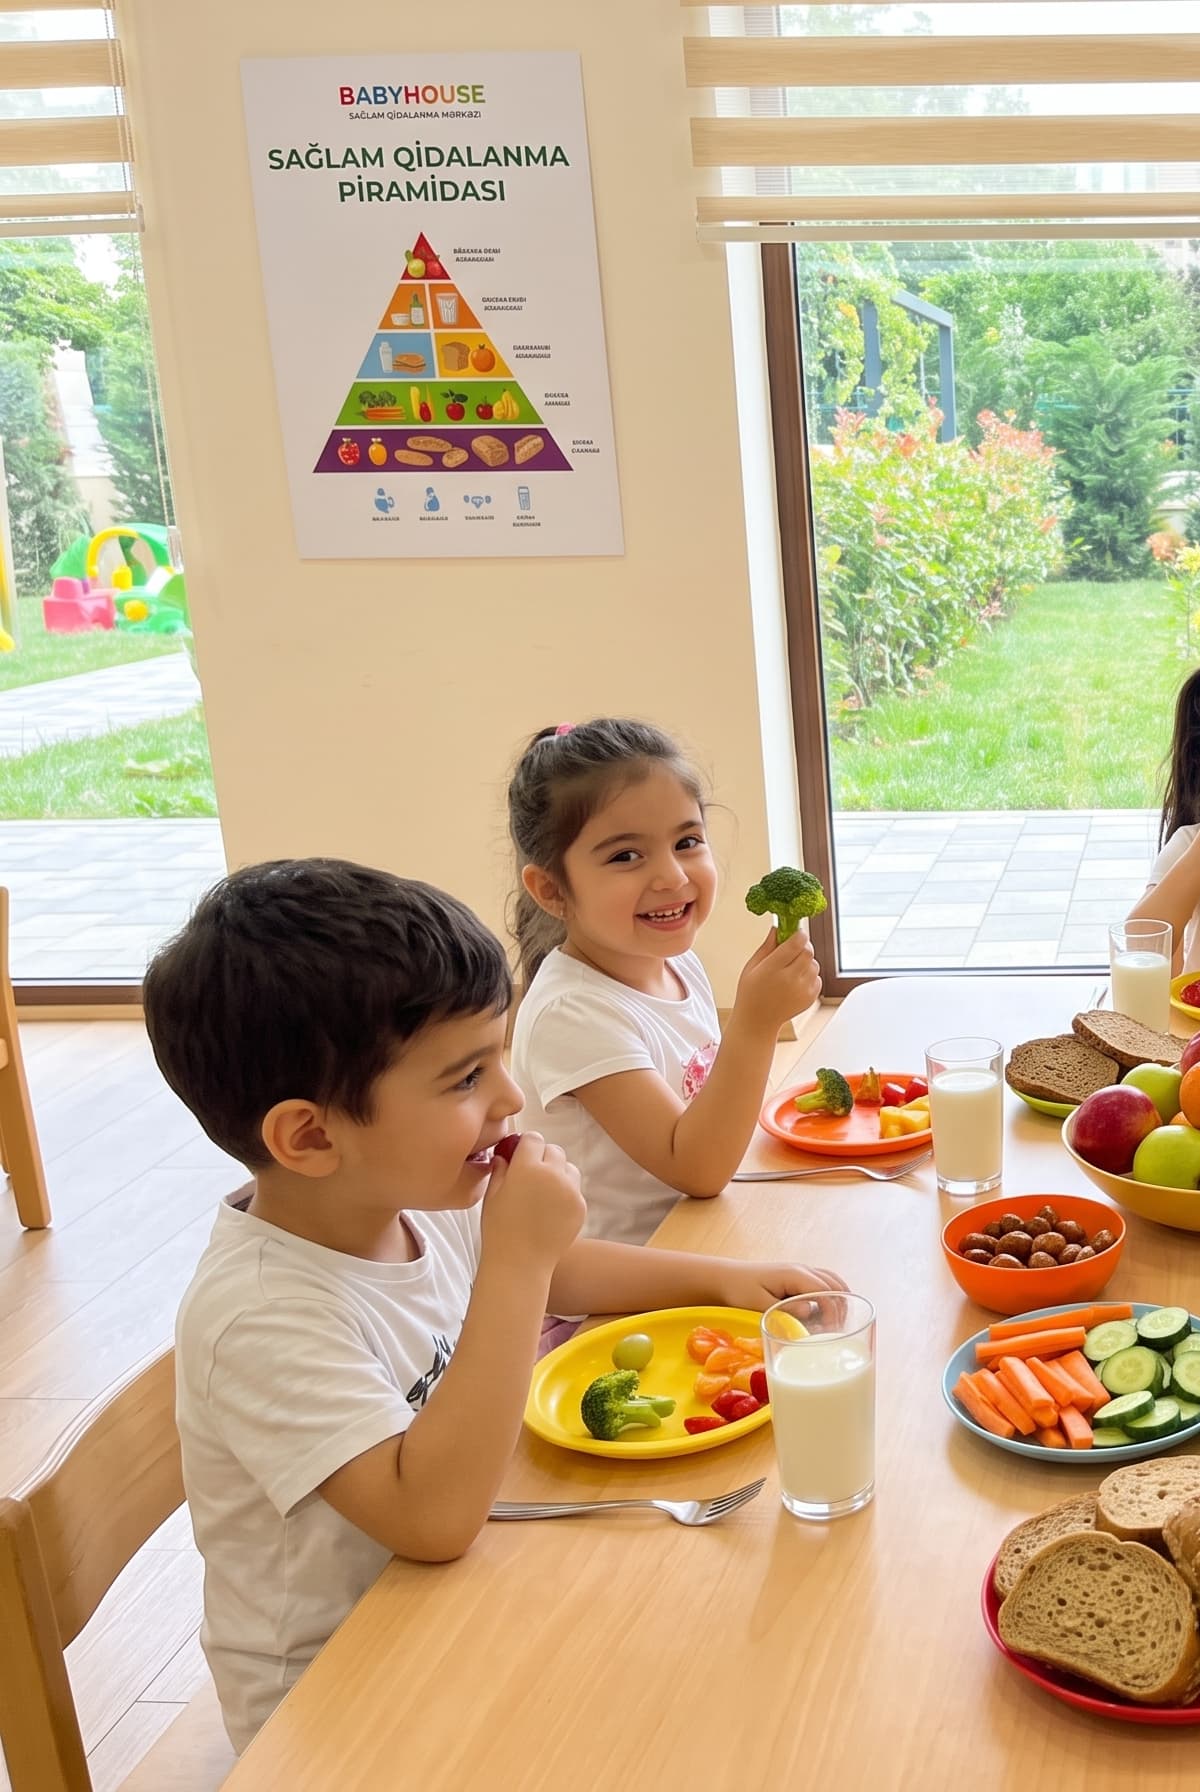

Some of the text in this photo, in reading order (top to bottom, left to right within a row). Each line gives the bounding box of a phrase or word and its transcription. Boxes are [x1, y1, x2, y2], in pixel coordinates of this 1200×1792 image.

[340, 84, 486, 105] BABYHOUSE
[267, 139, 570, 172] SAĞLAM QİDALANMA
[338, 174, 506, 203] PİRAMİDASI
